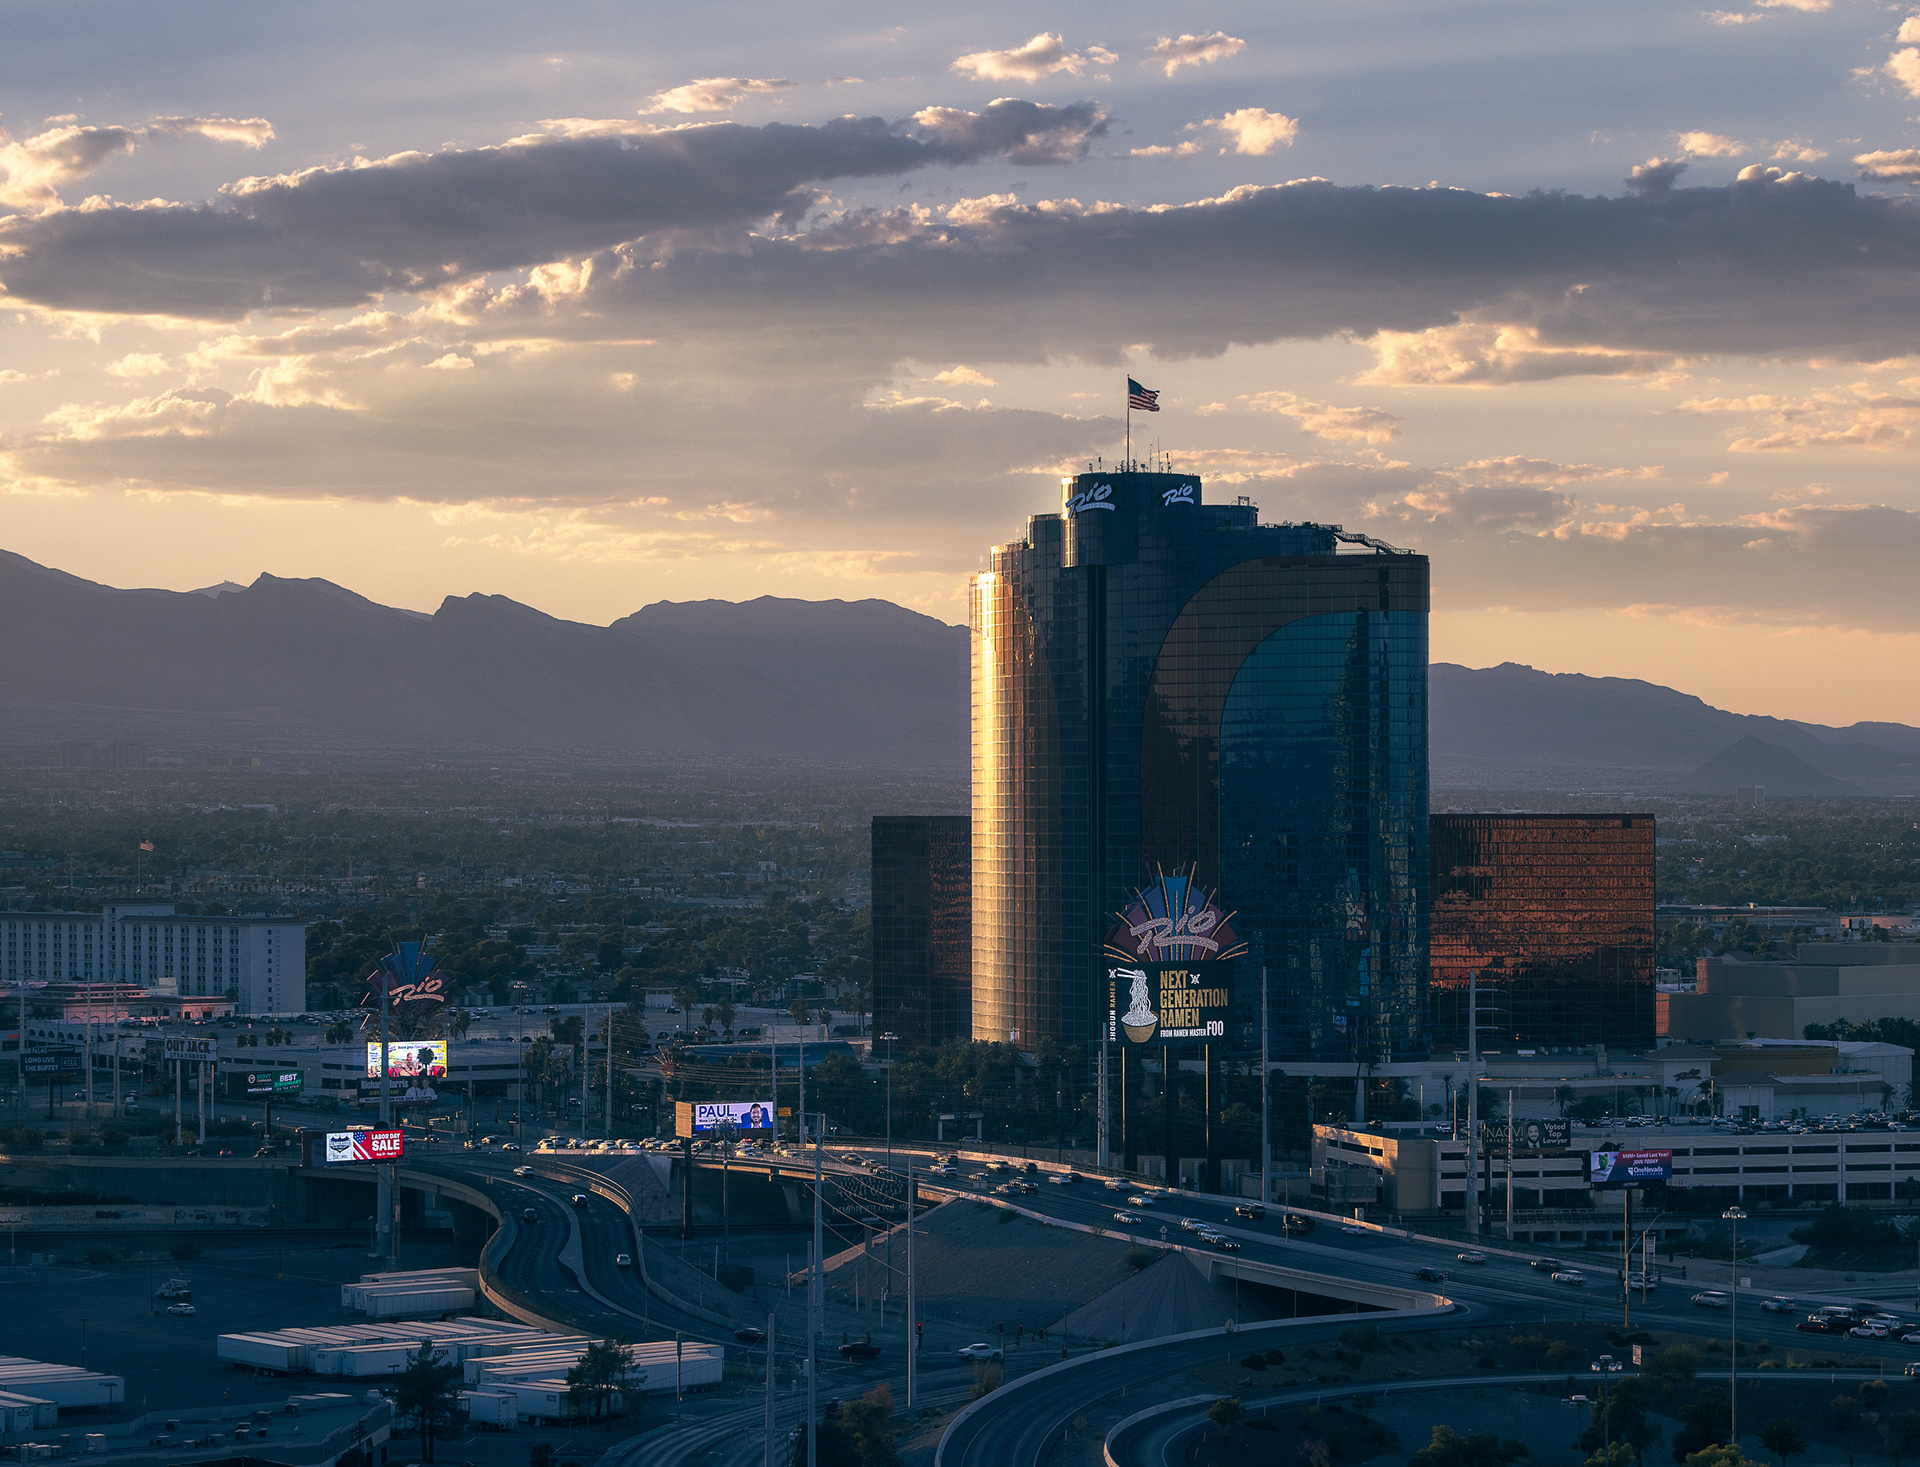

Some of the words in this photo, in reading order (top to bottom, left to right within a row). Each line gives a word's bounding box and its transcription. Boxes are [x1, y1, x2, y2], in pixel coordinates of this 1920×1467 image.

[1066, 482, 1115, 519] Rio
[1162, 483, 1194, 506] Rio
[1130, 906, 1219, 955] Rio
[1160, 970, 1188, 989] NEXT
[388, 976, 445, 1006] Rio
[1160, 988, 1228, 1008] GENERATION
[1160, 1008, 1200, 1027] RAMEN
[1173, 1029, 1188, 1037] RAMEN
[1206, 1021, 1224, 1036] FOO
[279, 1073, 298, 1082] BEST
[360, 1080, 382, 1089] Richar
[699, 1105, 738, 1118] PAUL.
[1543, 1122, 1566, 1131] Voted
[1542, 1137, 1568, 1145] Lawyer
[1548, 1130, 1562, 1139] Top
[371, 1139, 400, 1152] SALE
[433, 1349, 450, 1357] XTRA
